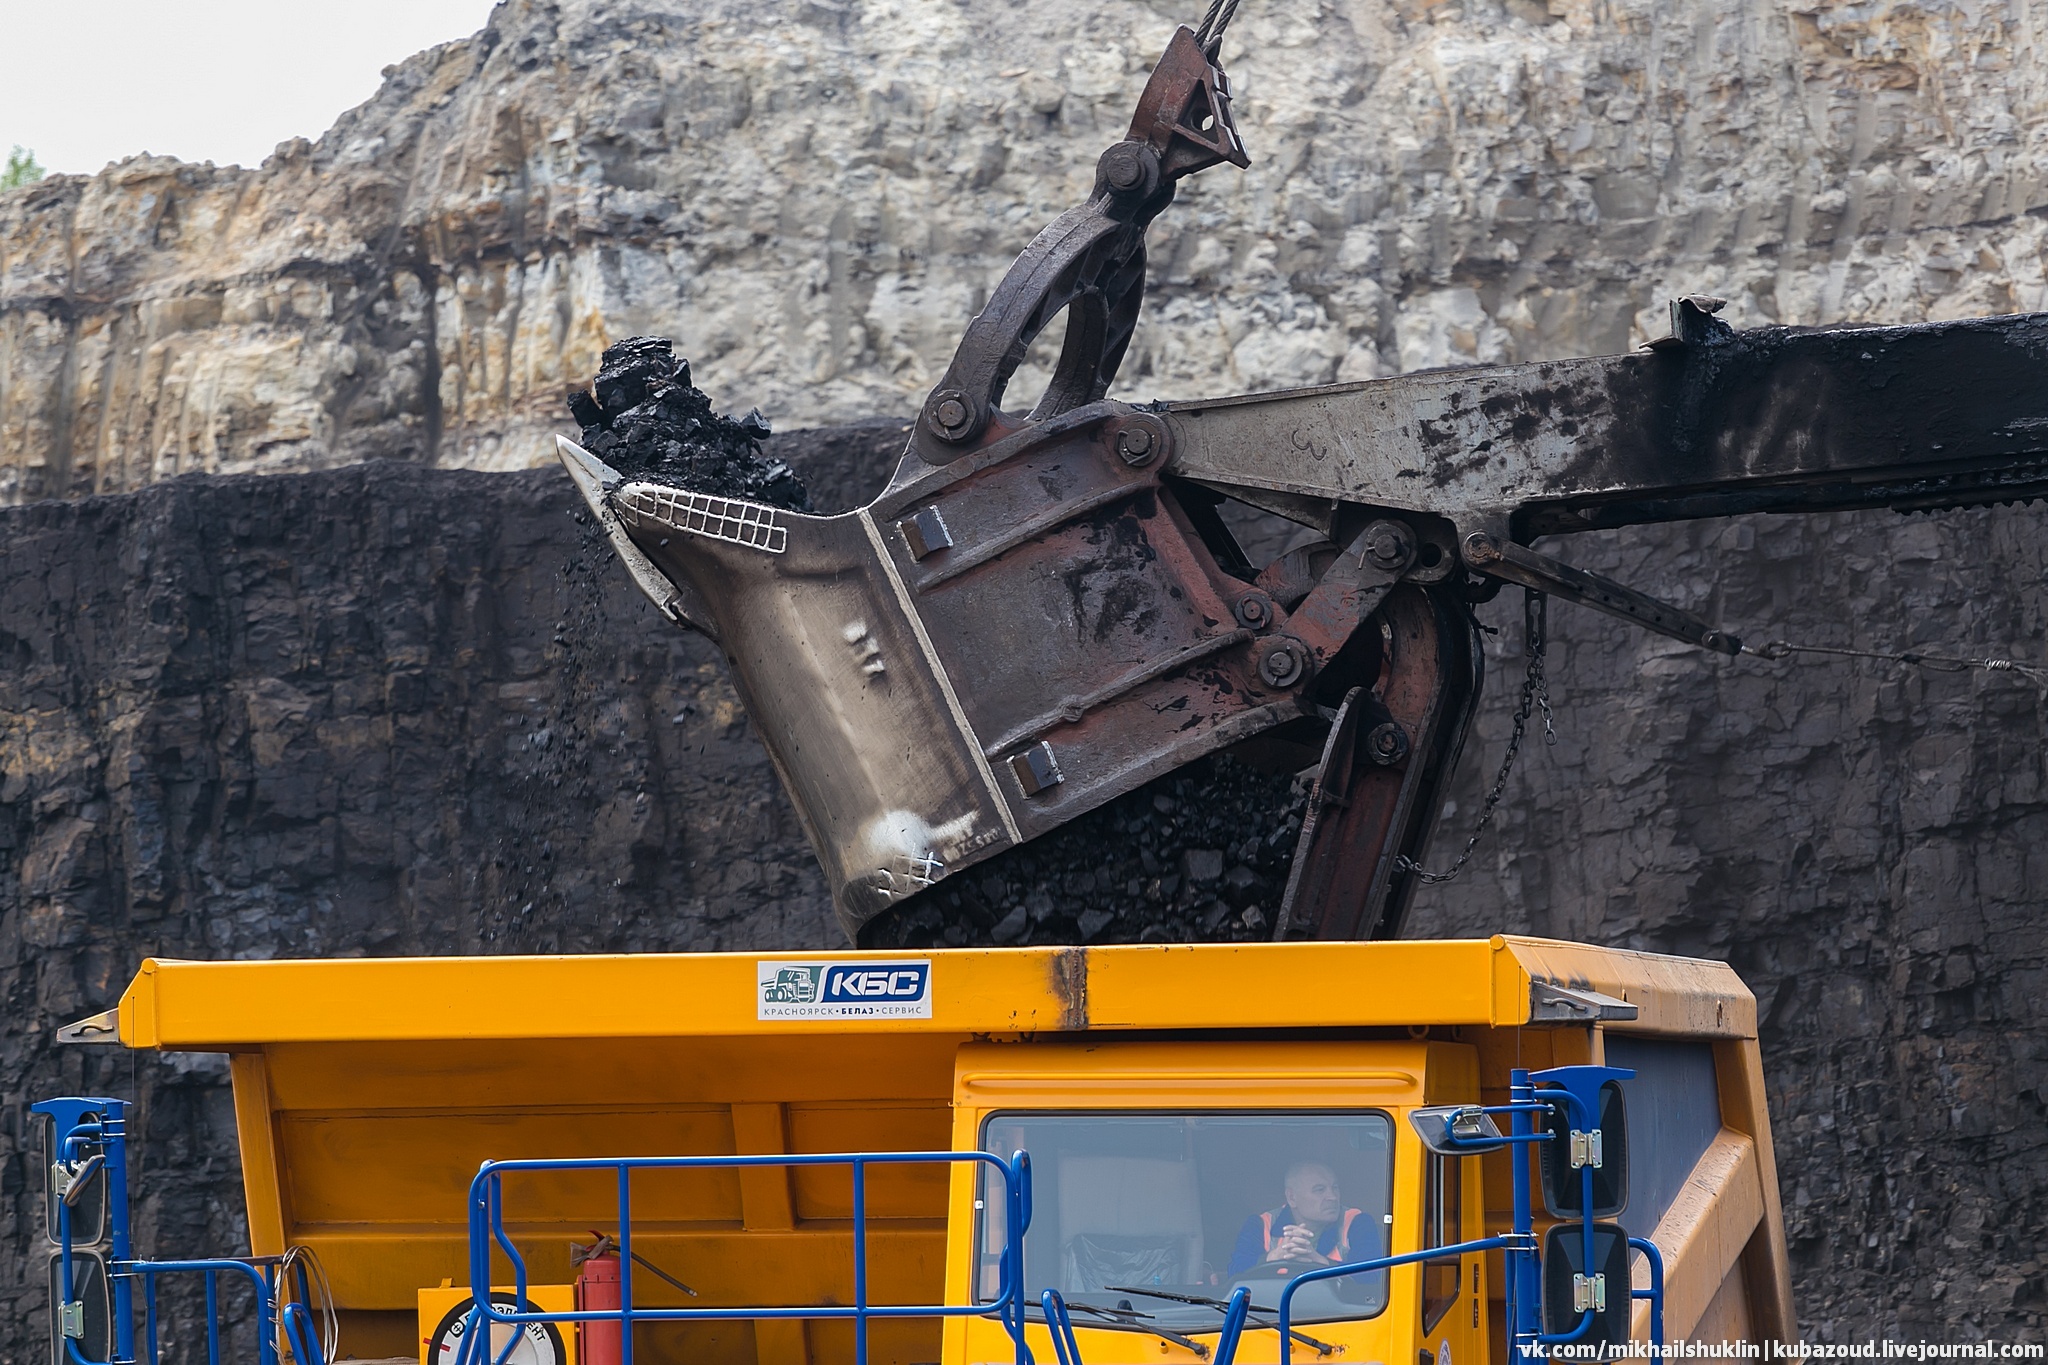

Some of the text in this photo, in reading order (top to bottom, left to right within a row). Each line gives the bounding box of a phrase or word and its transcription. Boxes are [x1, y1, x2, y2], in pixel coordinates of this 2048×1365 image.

[831, 971, 920, 996] КБС
[764, 1006, 922, 1016] КРАСНОЯРСК БЕЛАЗ СЕРВИС
